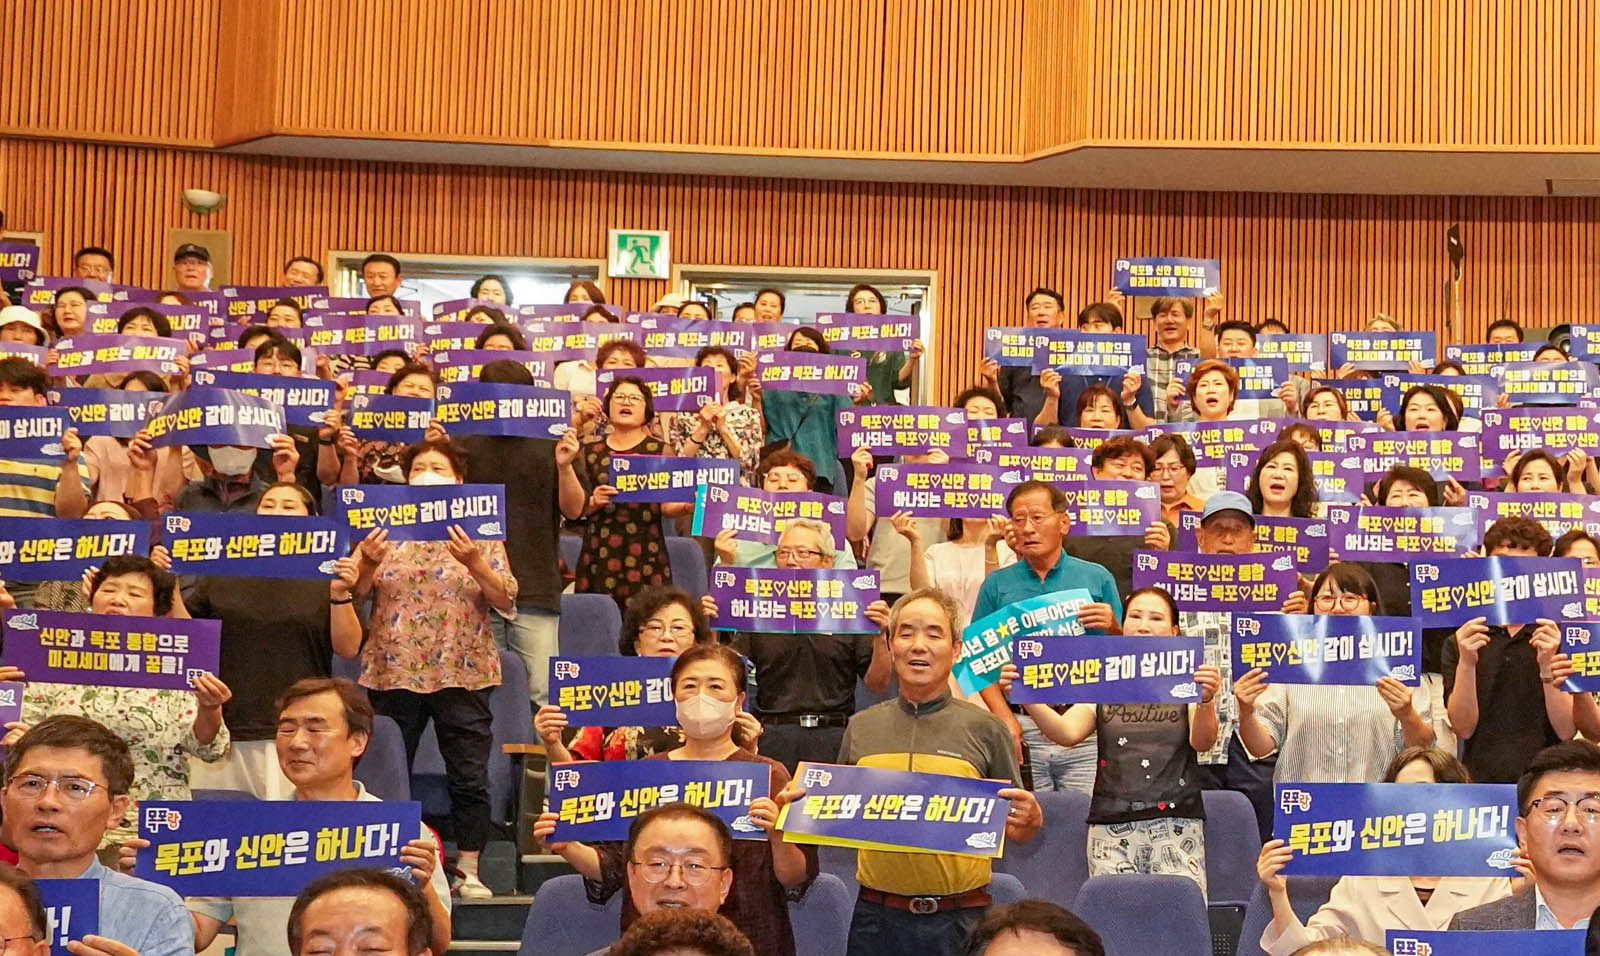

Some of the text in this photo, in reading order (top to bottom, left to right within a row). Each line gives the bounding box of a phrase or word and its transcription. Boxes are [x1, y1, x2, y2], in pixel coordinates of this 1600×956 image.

[420, 500, 447, 523] 같이
[450, 495, 498, 519] 삽시다!
[172, 530, 336, 561] 목포와 신안은 하나다!
[1499, 574, 1530, 601] 같이
[1533, 571, 1578, 597] 삽시다!
[40, 627, 189, 653] 신안과 목포 통합으로
[1323, 637, 1354, 662] 같이
[1358, 630, 1413, 659] 삽시다!
[48, 649, 183, 675] 미래세대에게 꿈을!
[1105, 654, 1136, 681] 같이
[1140, 649, 1196, 677] 삽시다!
[560, 792, 616, 825] 목포와
[684, 779, 753, 808] 하나다!
[803, 794, 995, 826] 목포와 신안은 하나다!
[1288, 805, 1508, 855] 목포와 신안은 하나다!
[155, 823, 400, 876] 목포와 신안은 하나다!
